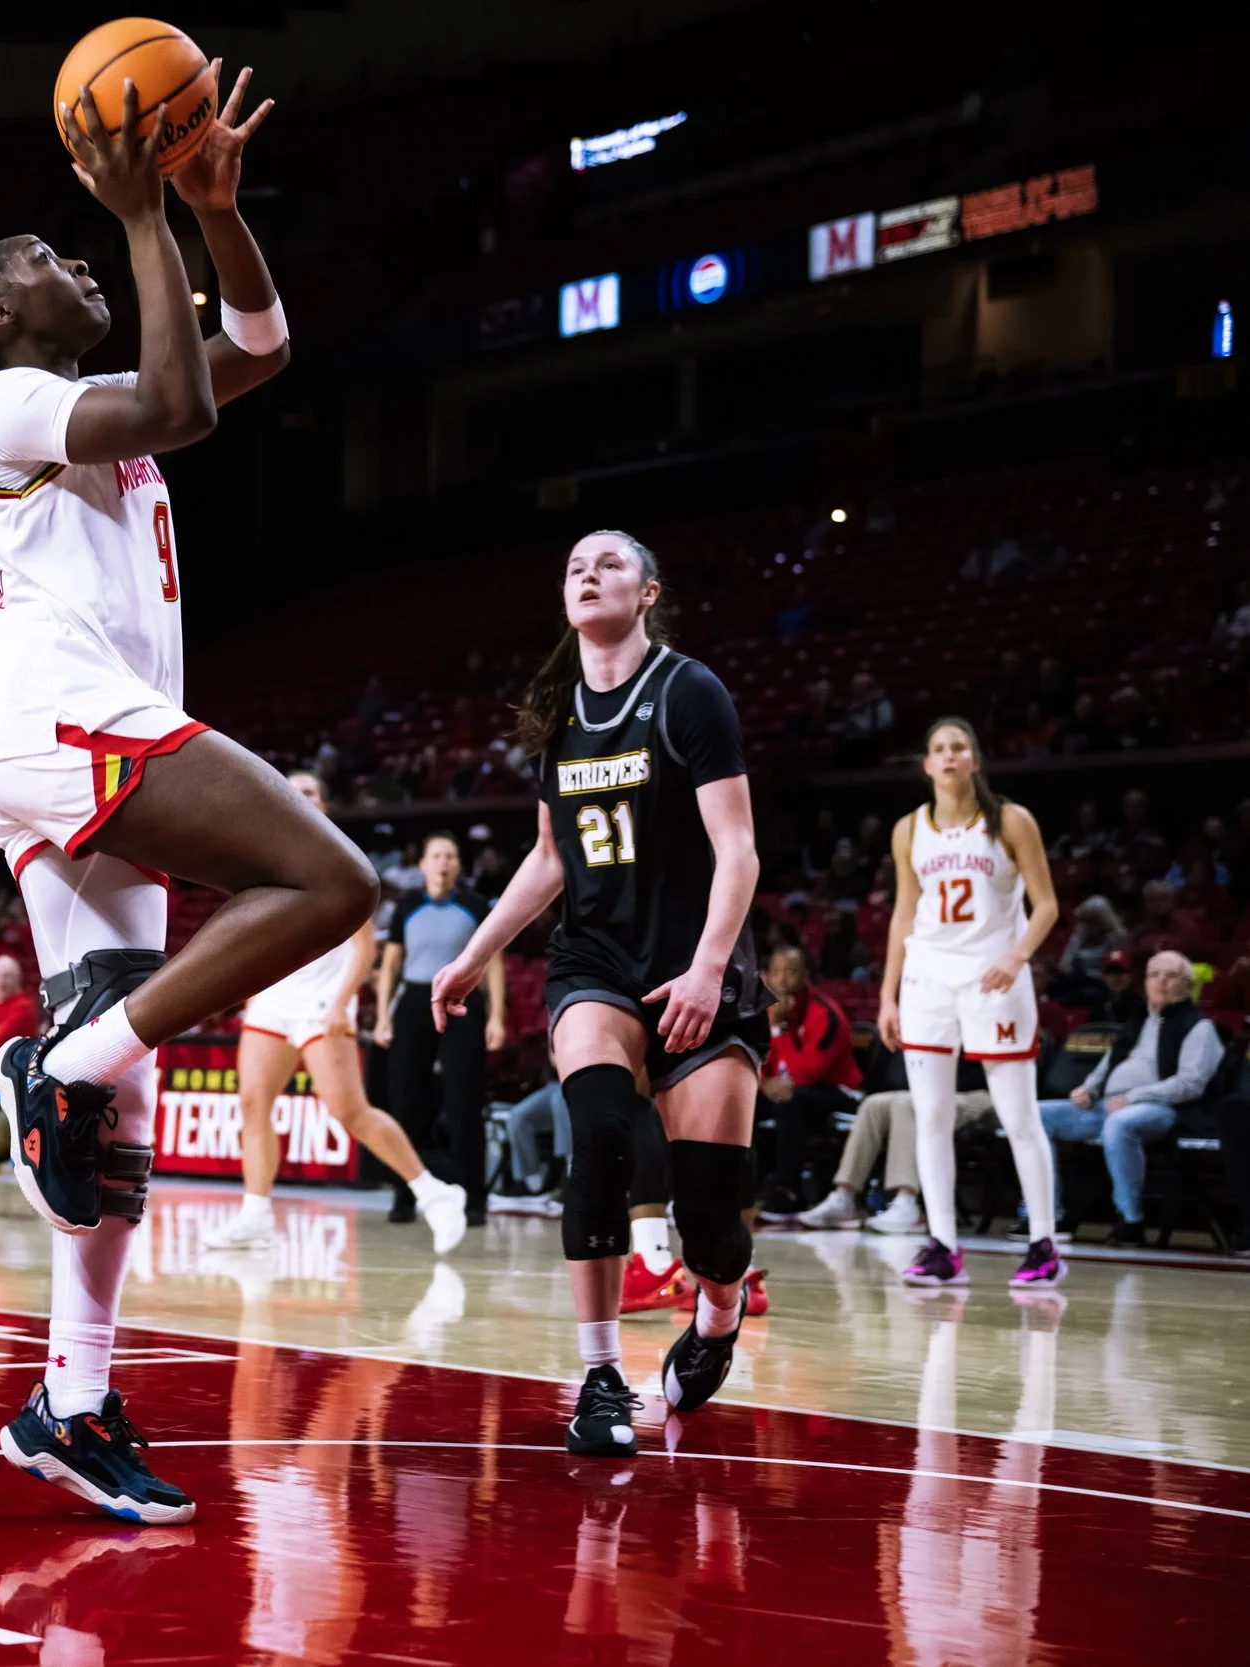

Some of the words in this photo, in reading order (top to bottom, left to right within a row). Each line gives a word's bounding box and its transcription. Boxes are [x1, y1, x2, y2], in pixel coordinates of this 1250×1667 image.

[153, 501, 178, 602] 9
[557, 749, 651, 795] RETRIEVERS
[577, 801, 635, 867] 21
[920, 854, 994, 877] MARYLAND
[938, 878, 975, 923] 12
[996, 1021, 1018, 1044] M
[172, 1069, 238, 1091] HOME
[161, 1091, 350, 1166] TERRPINS
